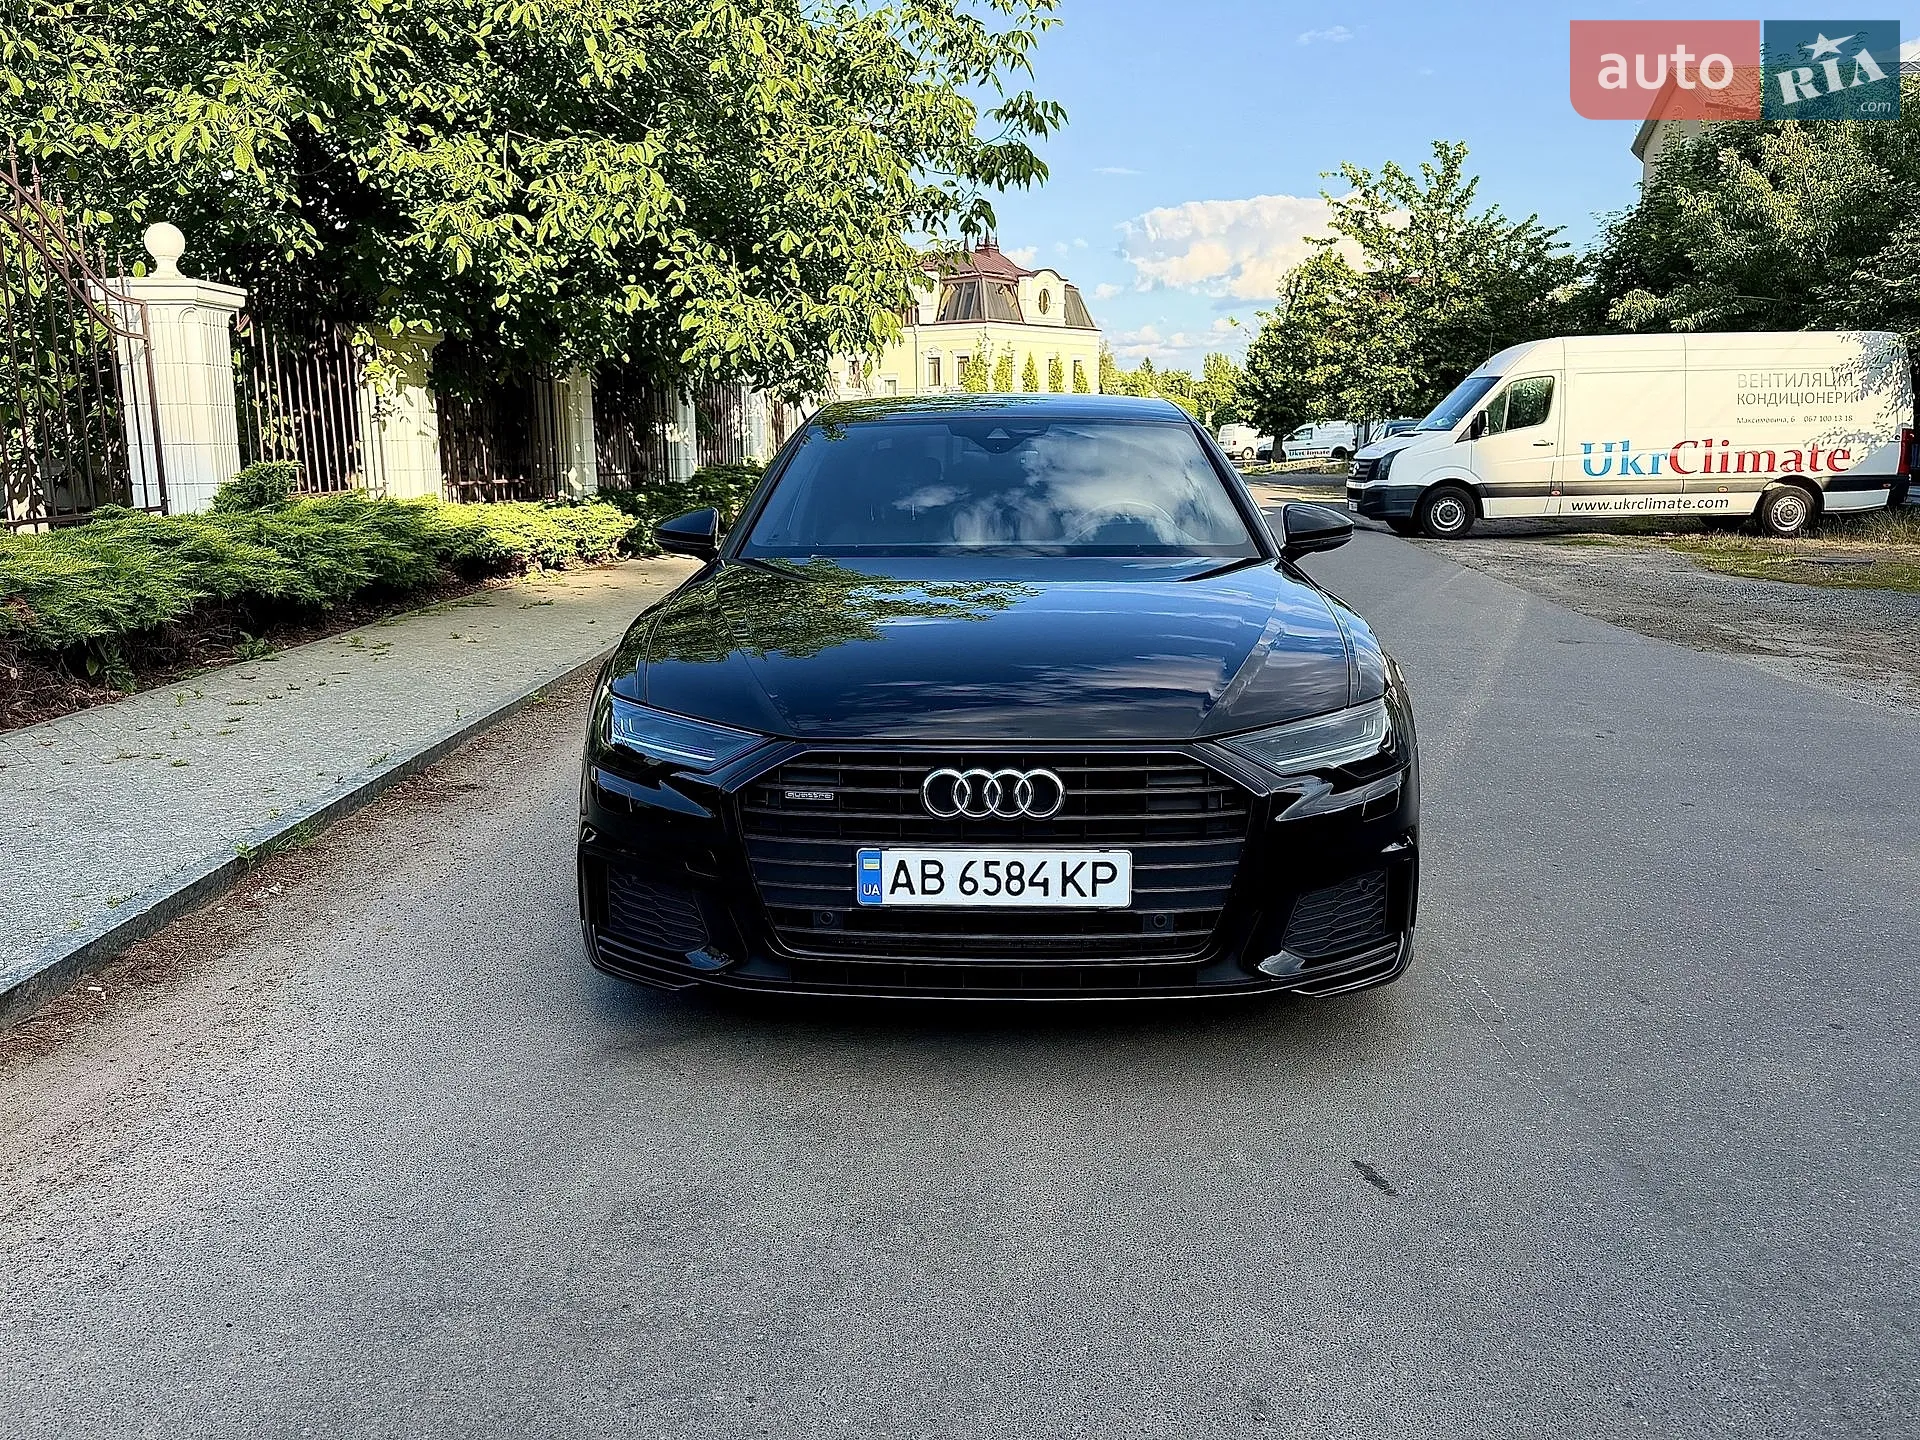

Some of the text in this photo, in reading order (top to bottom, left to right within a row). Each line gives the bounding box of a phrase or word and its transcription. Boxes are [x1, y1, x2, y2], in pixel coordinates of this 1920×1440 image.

[1737, 391, 1854, 408] КОНДИЦІОНЕРИ
[1580, 438, 1851, 477] UkrClimate
[1571, 496, 1729, 512] www.ukrclimate.com
[889, 859, 1119, 898] AB 6584 KP
[863, 884, 881, 896] UA
